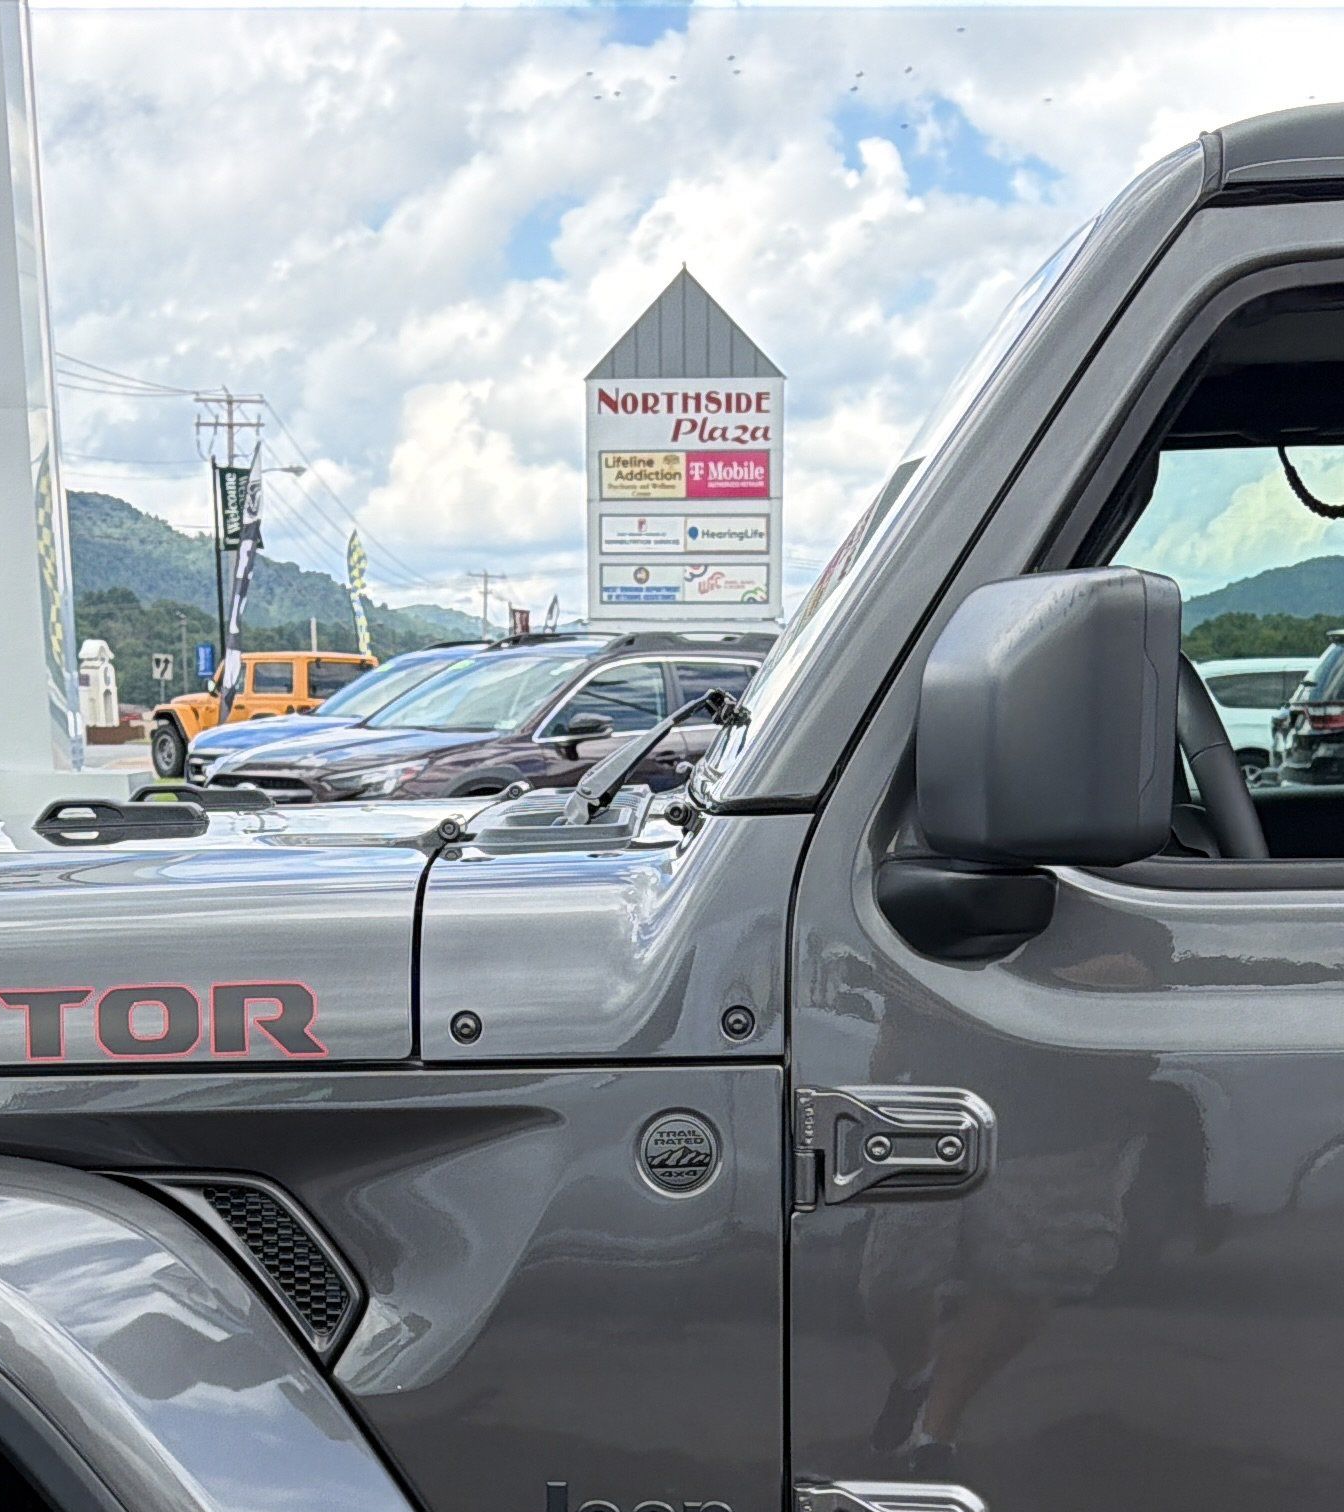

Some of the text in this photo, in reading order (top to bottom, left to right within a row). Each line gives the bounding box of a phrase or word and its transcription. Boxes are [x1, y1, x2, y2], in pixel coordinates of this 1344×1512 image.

[597, 387, 772, 415] NORTHSIDE
[670, 417, 772, 445] Plaza
[604, 456, 655, 469] Lifeline
[614, 470, 682, 482] Addiction
[707, 460, 765, 481] Mobile
[224, 472, 240, 535] Welcome
[701, 528, 765, 541] HearingLife
[656, 1129, 703, 1138] TRAIL
[653, 1137, 705, 1146] RATED
[659, 1169, 698, 1178] 4x4
